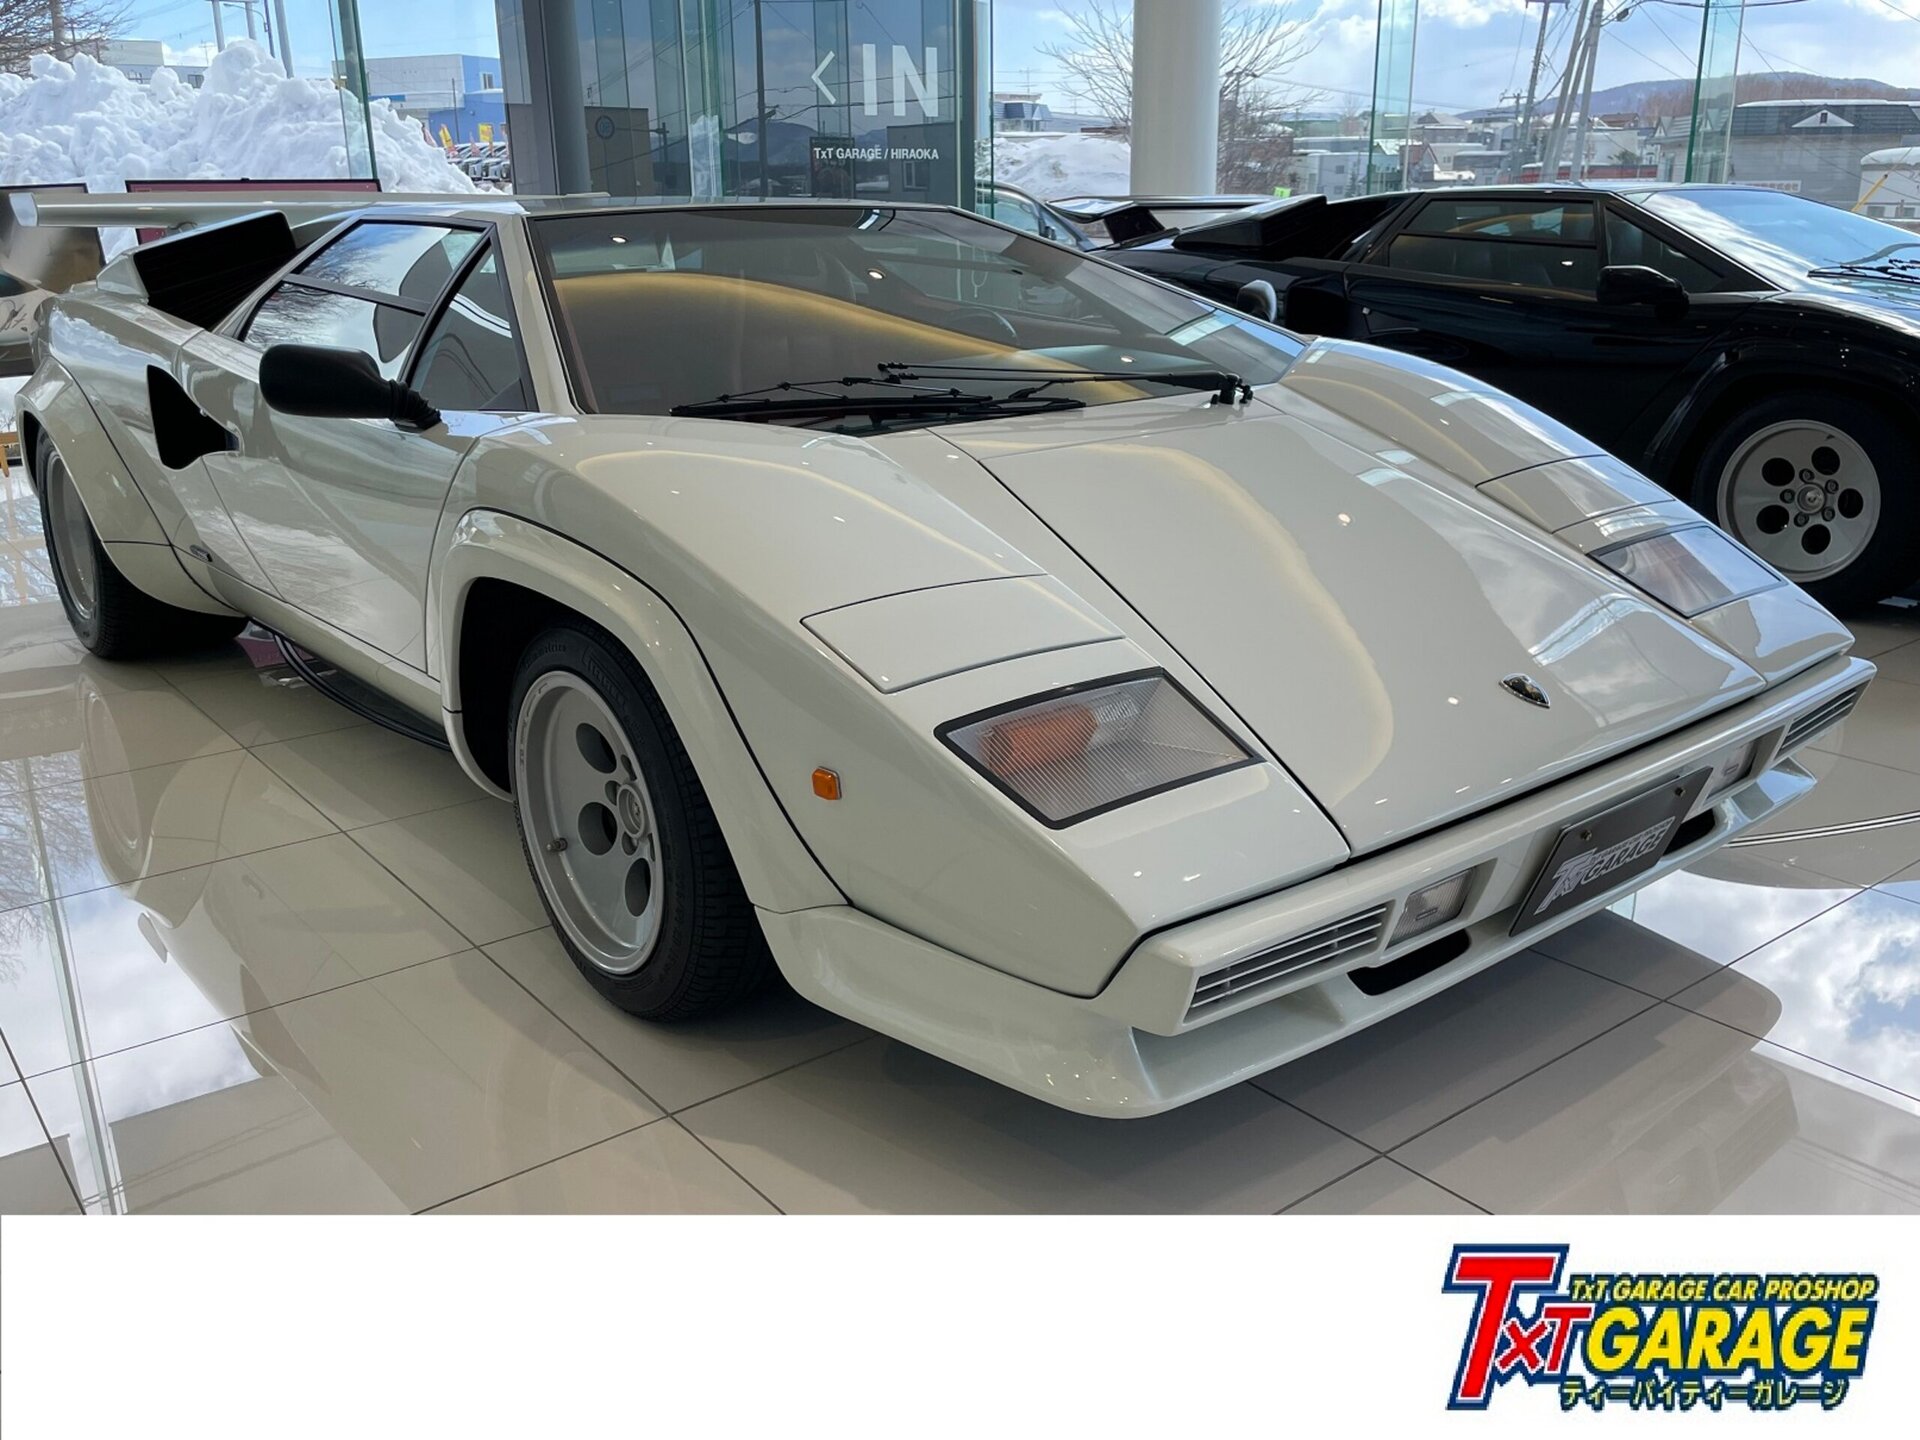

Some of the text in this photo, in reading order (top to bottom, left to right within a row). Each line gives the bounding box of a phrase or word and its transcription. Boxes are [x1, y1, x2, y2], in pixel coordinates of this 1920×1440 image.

[862, 43, 938, 117] IN
[836, 147, 882, 159] GARAGE
[890, 148, 939, 160] HIRAOKA
[1581, 828, 1668, 884] GARAGE
